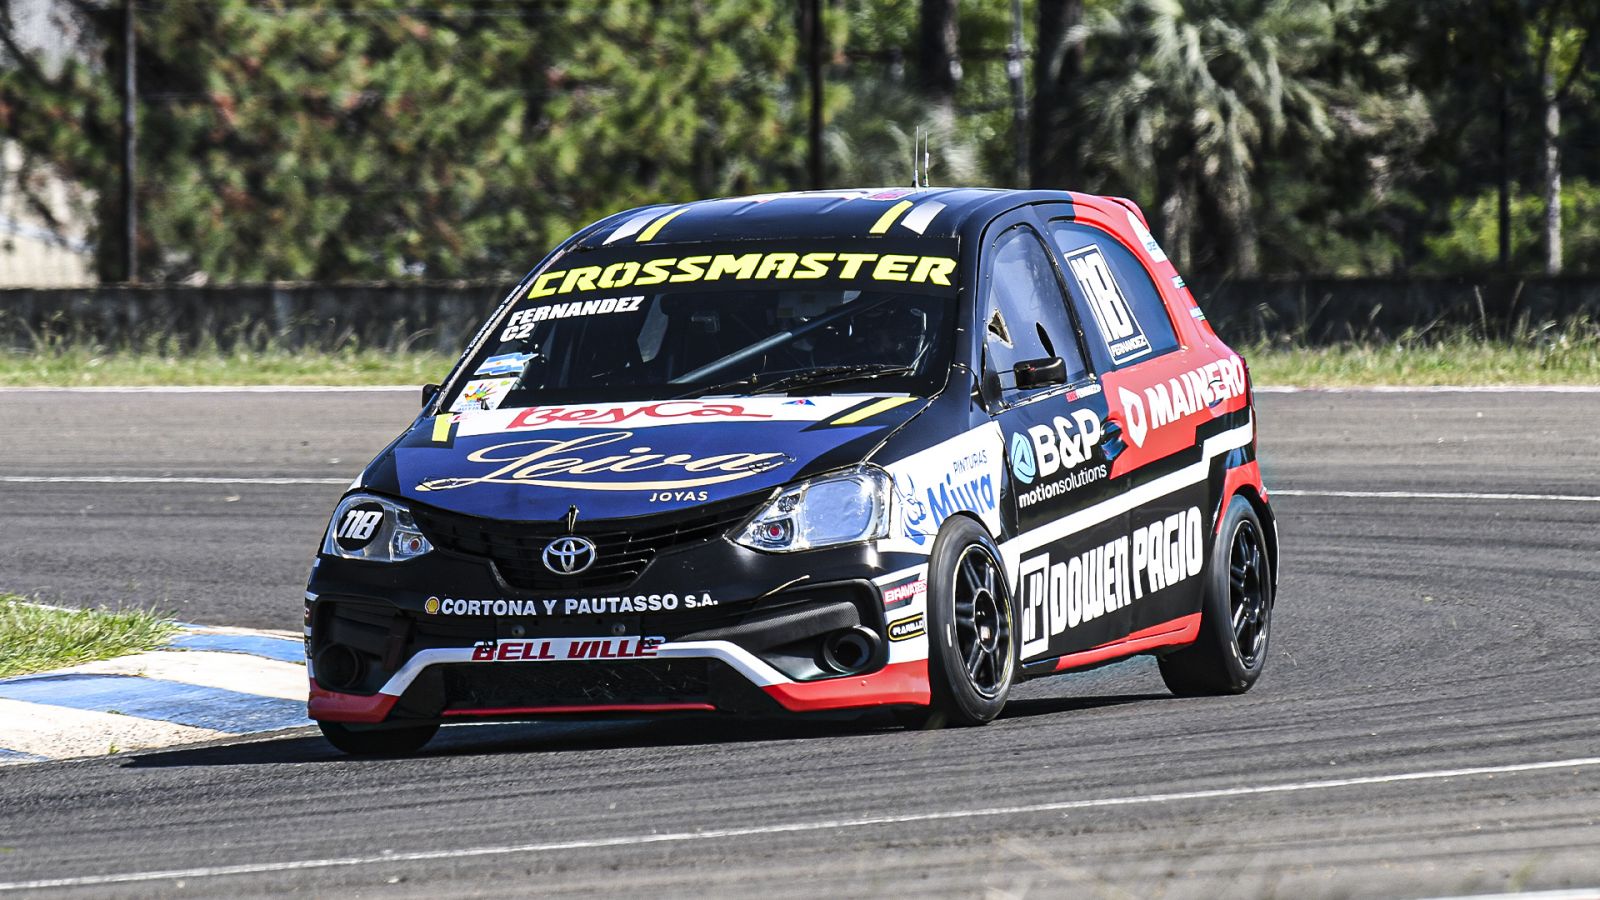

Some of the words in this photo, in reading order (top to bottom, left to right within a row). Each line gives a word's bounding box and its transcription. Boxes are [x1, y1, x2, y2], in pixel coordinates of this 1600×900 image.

[527, 252, 956, 299] CROSSMASTER
[507, 296, 644, 327] FERNANDEZ
[500, 323, 535, 342] C2
[1144, 355, 1245, 429] MAINERO
[415, 431, 790, 491] Leiva
[953, 449, 988, 473] PINTURAS
[1028, 408, 1101, 478] B&P
[649, 491, 708, 502] JOYAS
[927, 473, 996, 526] Miura
[1018, 463, 1107, 508] motionsolutions
[338, 509, 384, 540] 118
[1133, 506, 1203, 599] PAGIO
[440, 598, 536, 616] CORTONA
[545, 599, 557, 615] Y
[565, 594, 678, 614] PAUTASSO
[685, 592, 719, 608] S.A.
[471, 641, 556, 661] BELL
[567, 637, 664, 659] VILLE
